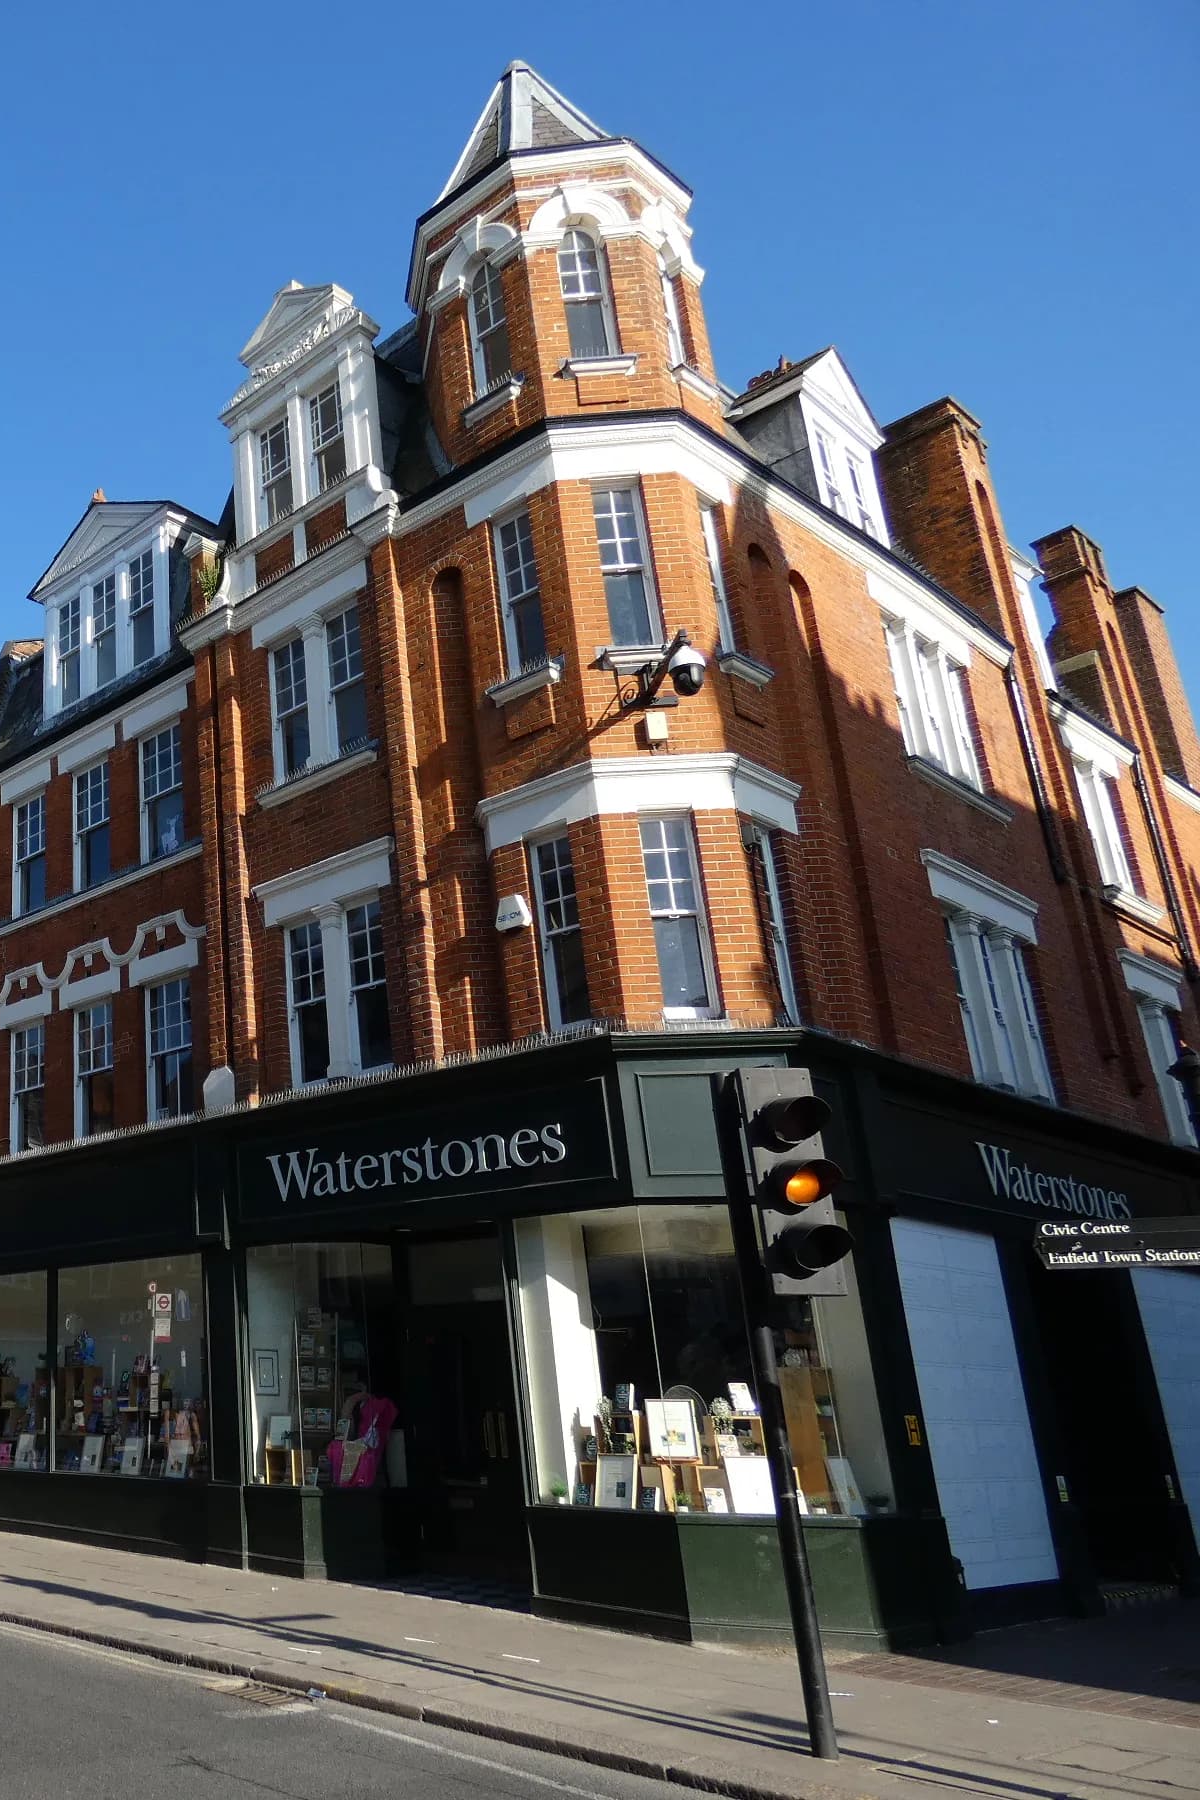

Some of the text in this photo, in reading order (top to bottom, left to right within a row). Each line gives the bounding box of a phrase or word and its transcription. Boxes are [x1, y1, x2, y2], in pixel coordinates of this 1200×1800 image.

[265, 1122, 567, 1202] Waterstones
[974, 1140, 1133, 1219] Waterstones
[1041, 1221, 1131, 1236] Civic Centre
[1048, 1248, 1198, 1265] Enfield Town Station
